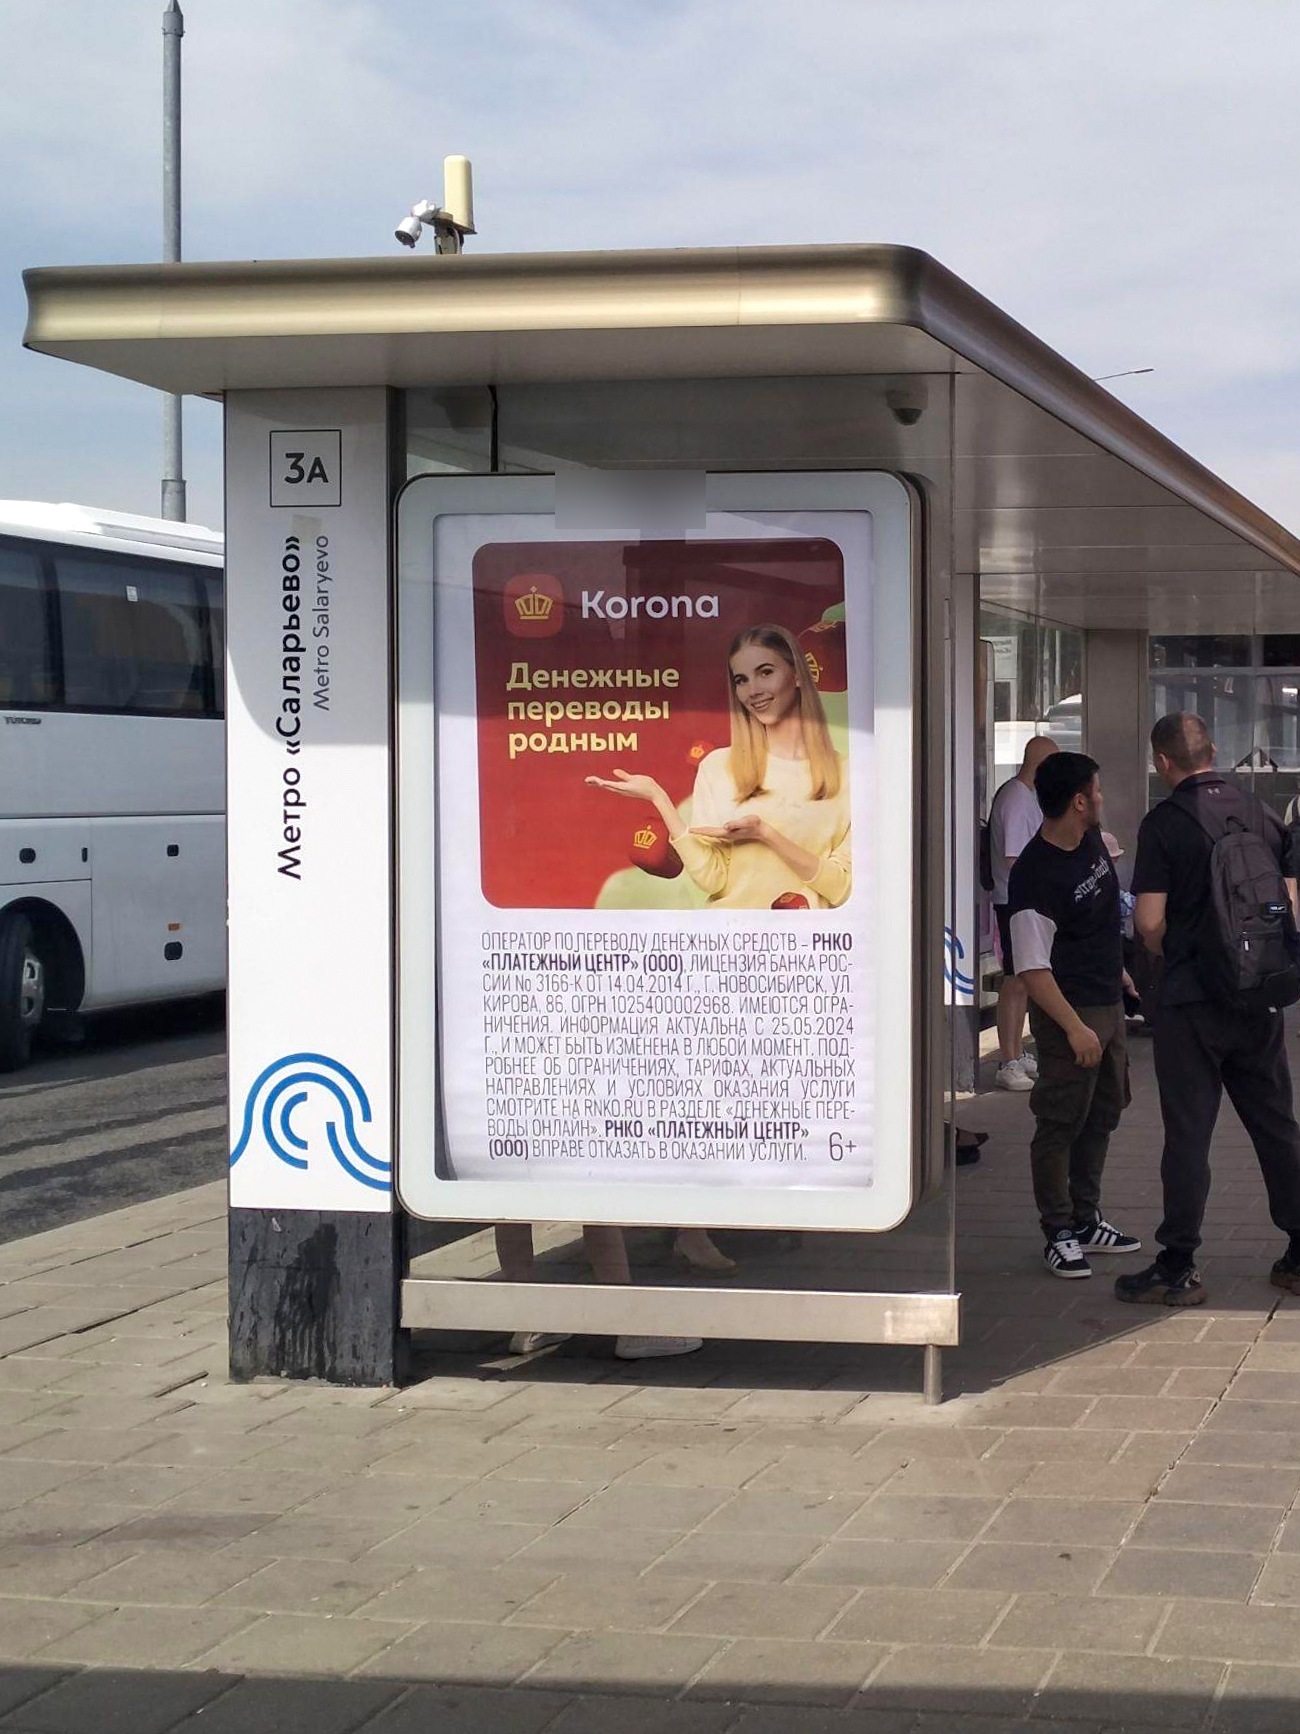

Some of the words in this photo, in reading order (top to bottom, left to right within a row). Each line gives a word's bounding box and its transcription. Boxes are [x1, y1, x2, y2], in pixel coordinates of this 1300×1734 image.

[284, 452, 329, 484] 3А
[312, 535, 333, 638] Salaryevo
[581, 589, 720, 619] Korona
[275, 535, 307, 755] «Саларьево»
[312, 644, 330, 711] Metro
[506, 662, 680, 691] Денежные
[507, 699, 670, 728] переводы
[508, 731, 638, 759] родным
[277, 767, 307, 881] Метро
[482, 932, 551, 950] ОПЕРАТОР
[555, 932, 573, 950] ПО
[576, 932, 647, 953] ПЕРЕВОДУ
[651, 933, 730, 953] ДЕНЕЖНЫХ
[733, 933, 797, 953] СРЕДСТВ
[812, 932, 853, 951] РНКО
[482, 951, 581, 972] «ПЛАТЕЖНЫЙ
[585, 953, 639, 974] ЦЕНТР»
[690, 954, 766, 974] ЛИЦЕНЗИЯ
[770, 954, 816, 972] БАНКА
[819, 954, 853, 972] РОС-
[482, 974, 511, 992] СИИ
[536, 974, 583, 993] 3166-К
[586, 974, 603, 993] ОТ
[608, 974, 682, 993] 14.04.2014
[718, 975, 828, 994] НОВОСИБИРСК,
[832, 975, 853, 995] УЛ.
[483, 995, 541, 1014] КИРОВА,
[546, 995, 567, 1014] 86,
[571, 995, 606, 1014] ОГРН
[611, 996, 734, 1014] 1025400002968.
[739, 996, 808, 1014] ИМЕЮТСЯ
[813, 996, 854, 1014] ОГРА-
[484, 1015, 553, 1033] НИЧЕНИЯ.
[560, 1016, 658, 1037] ИНФОРМАЦИЯ
[666, 1016, 748, 1036] АКТУАЛЬНА
[755, 1017, 764, 1035] С
[772, 1017, 854, 1035] 25.05.2024
[501, 1036, 510, 1053] И
[514, 1036, 561, 1054] МОЖЕТ
[565, 1036, 603, 1054] БЫТЬ
[606, 1037, 679, 1055] ИЗМЕНЕНА
[684, 1038, 692, 1056] В
[696, 1035, 747, 1056] ЛЮБОЙ
[752, 1038, 814, 1056] МОМЕНТ.
[818, 1038, 855, 1058] ПОД-
[485, 1057, 536, 1075] РОБНЕЕ
[543, 1057, 561, 1075] ОБ
[568, 1057, 679, 1077] ОГРАНИЧЕНИЯХ,
[686, 1059, 754, 1077] ТАРИФАХ,
[760, 1059, 856, 1079] АКТУАЛЬНЫХ
[485, 1077, 596, 1096] НАПРАВЛЕНИЯХ
[607, 1079, 616, 1096] И
[628, 1079, 703, 1098] УСЛОВИЯХ
[713, 1079, 789, 1098] ОКАЗАНИЯ
[801, 1080, 856, 1099] УСЛУГИ
[486, 1098, 558, 1116] СМОТРИТЕ
[562, 1098, 580, 1116] НА
[584, 1099, 643, 1117] RNKO.RU
[648, 1100, 656, 1117] В
[660, 1100, 721, 1120] РАЗДЕЛЕ
[726, 1100, 811, 1120] «ДЕНЕЖНЫЕ
[815, 1101, 856, 1119] ПЕРЕ-
[487, 1119, 528, 1138] ВОДЫ
[532, 1117, 601, 1138] ОНЛАЙН».
[605, 1120, 643, 1138] РНКО
[647, 1118, 748, 1139] «ПЛАТЕЖНЫЙ
[753, 1122, 810, 1142] ЦЕНТР»
[488, 1139, 529, 1160] (ООО)
[532, 1140, 585, 1158] ВПРАВЕ
[588, 1140, 656, 1158] ОТКАЗАТЬ
[659, 1141, 668, 1159] В
[672, 1141, 746, 1160] ОКАЗАНИИ
[751, 1142, 807, 1162] УСЛУГИ.
[829, 1131, 857, 1161] 6+
